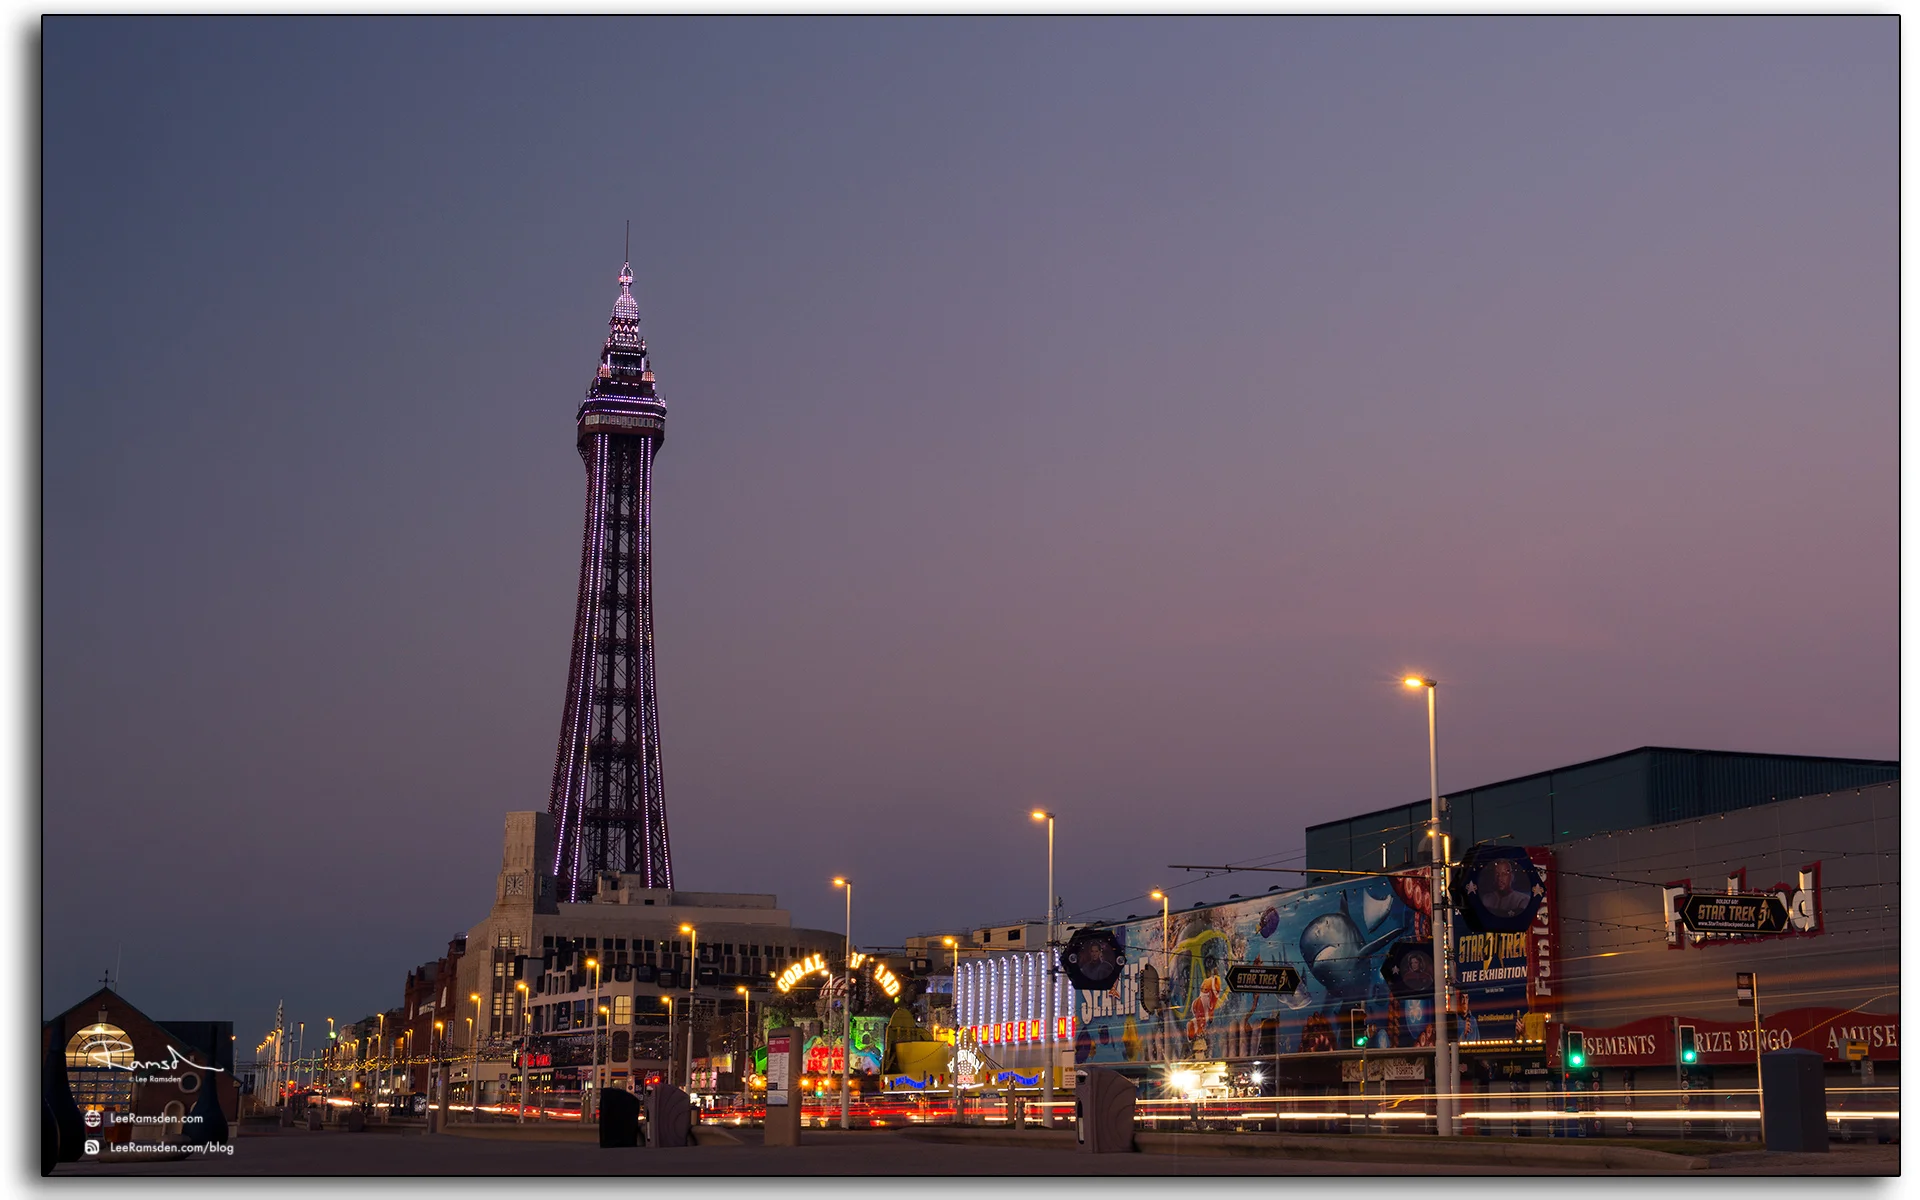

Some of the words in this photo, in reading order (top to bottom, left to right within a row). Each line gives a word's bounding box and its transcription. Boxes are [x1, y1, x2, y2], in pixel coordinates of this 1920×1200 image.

[1697, 904, 1726, 920] STAR
[1729, 905, 1756, 921] TREK
[1533, 864, 1552, 996] Funlad
[1459, 934, 1484, 963] STAR
[1500, 931, 1527, 959] TREK
[777, 953, 825, 993] CORAL
[1237, 973, 1257, 984] STAR
[1259, 974, 1278, 985] TREK
[1462, 971, 1477, 982] THE
[1479, 966, 1528, 981] EXHIBITION
[1081, 989, 1113, 1024] SEA
[971, 1016, 1077, 1042] AMUSEMN
[1694, 1031, 1733, 1053] RIZE
[1737, 1028, 1792, 1051] BINGO
[1826, 1024, 1899, 1049] AMUSE
[1556, 1034, 1656, 1057] ASEMENTS
